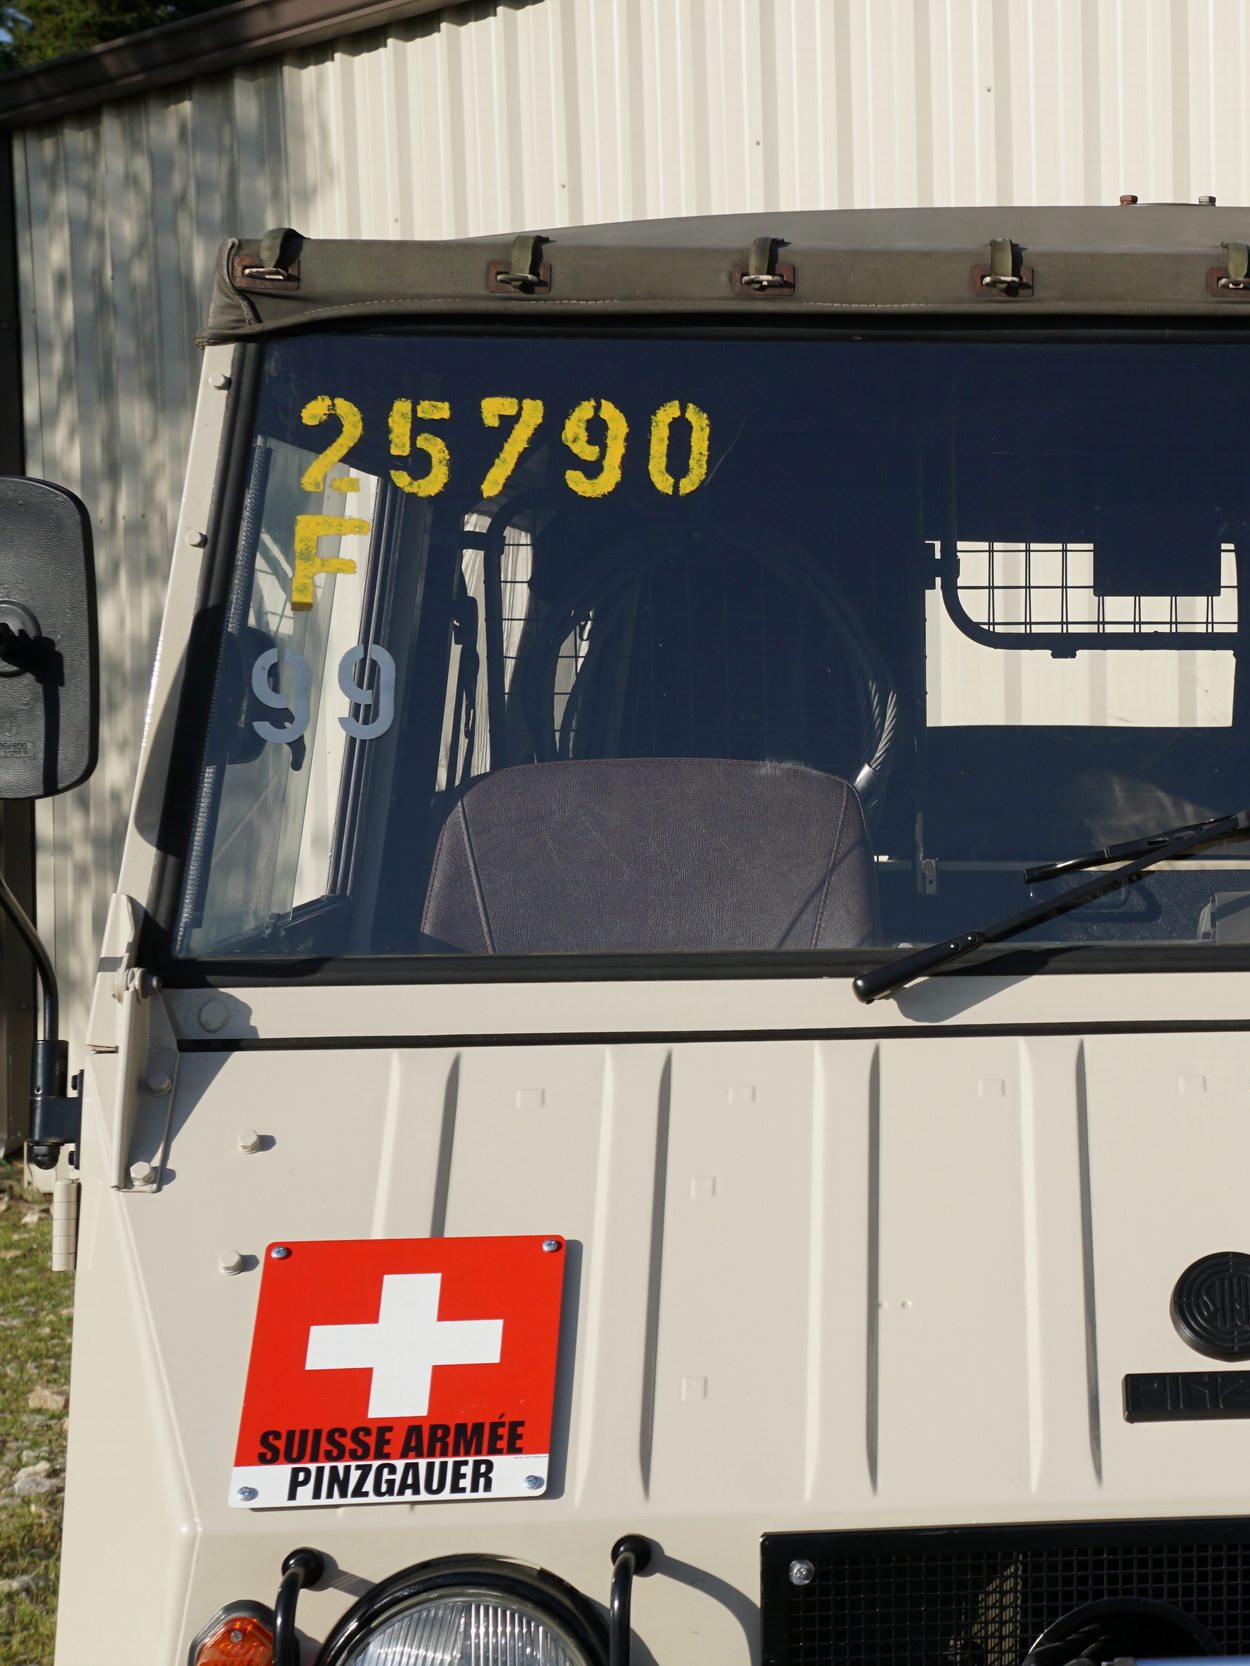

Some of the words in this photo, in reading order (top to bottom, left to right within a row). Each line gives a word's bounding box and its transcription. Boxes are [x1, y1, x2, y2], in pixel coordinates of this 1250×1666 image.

[300, 396, 711, 498] 25790
[291, 514, 371, 612] F
[252, 643, 396, 744] 99
[257, 1426, 393, 1465] SUISSE
[399, 1412, 525, 1459] ARMÉE
[287, 1458, 494, 1501] PINZGAUER
